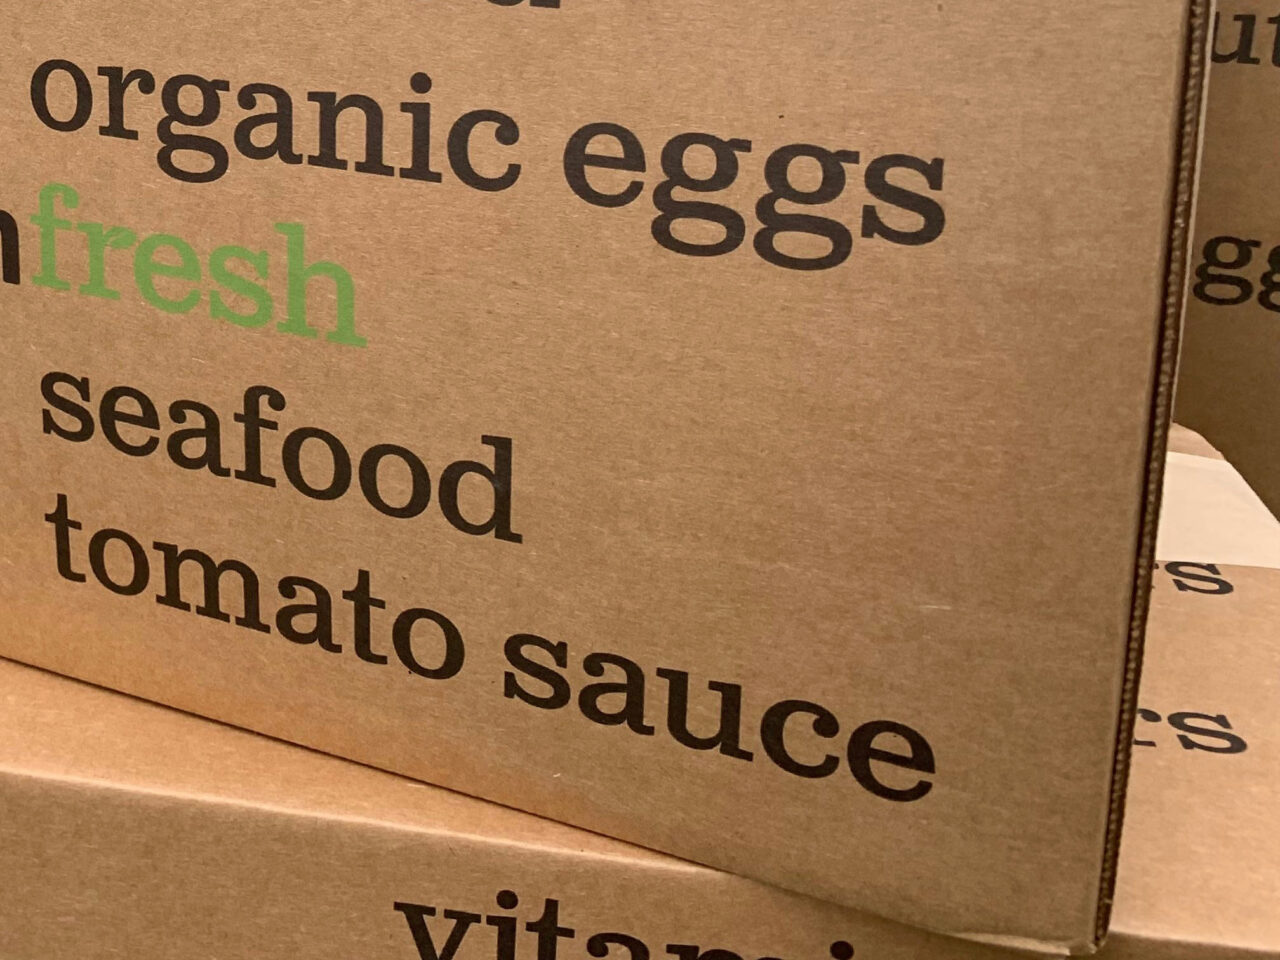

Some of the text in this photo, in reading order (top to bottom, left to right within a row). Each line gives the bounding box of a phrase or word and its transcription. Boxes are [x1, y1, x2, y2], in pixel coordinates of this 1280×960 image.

[30, 59, 946, 271] organic eggs
[40, 371, 523, 545] seafood
[45, 492, 937, 803] tomato sauce
